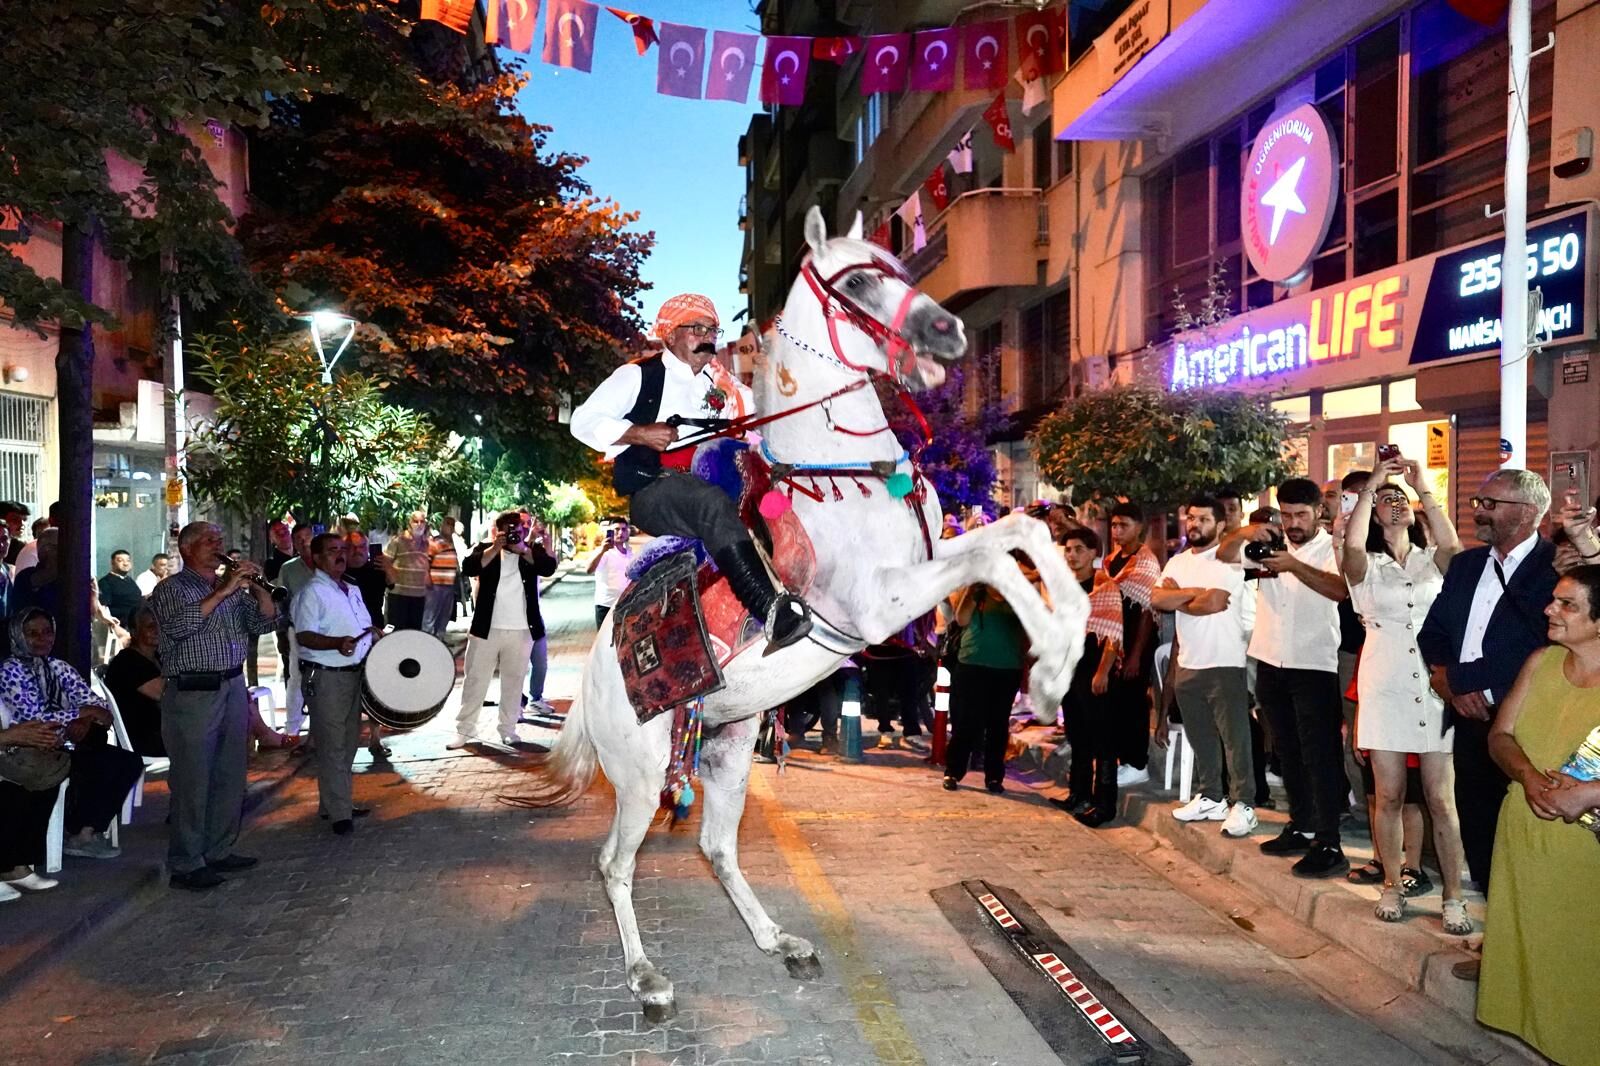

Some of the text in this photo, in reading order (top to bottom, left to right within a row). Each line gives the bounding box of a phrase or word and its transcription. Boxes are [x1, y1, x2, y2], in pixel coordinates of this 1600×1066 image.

[1459, 253, 1502, 297] 235
[1542, 232, 1580, 277] 50
[1448, 316, 1503, 351] MANİSA
